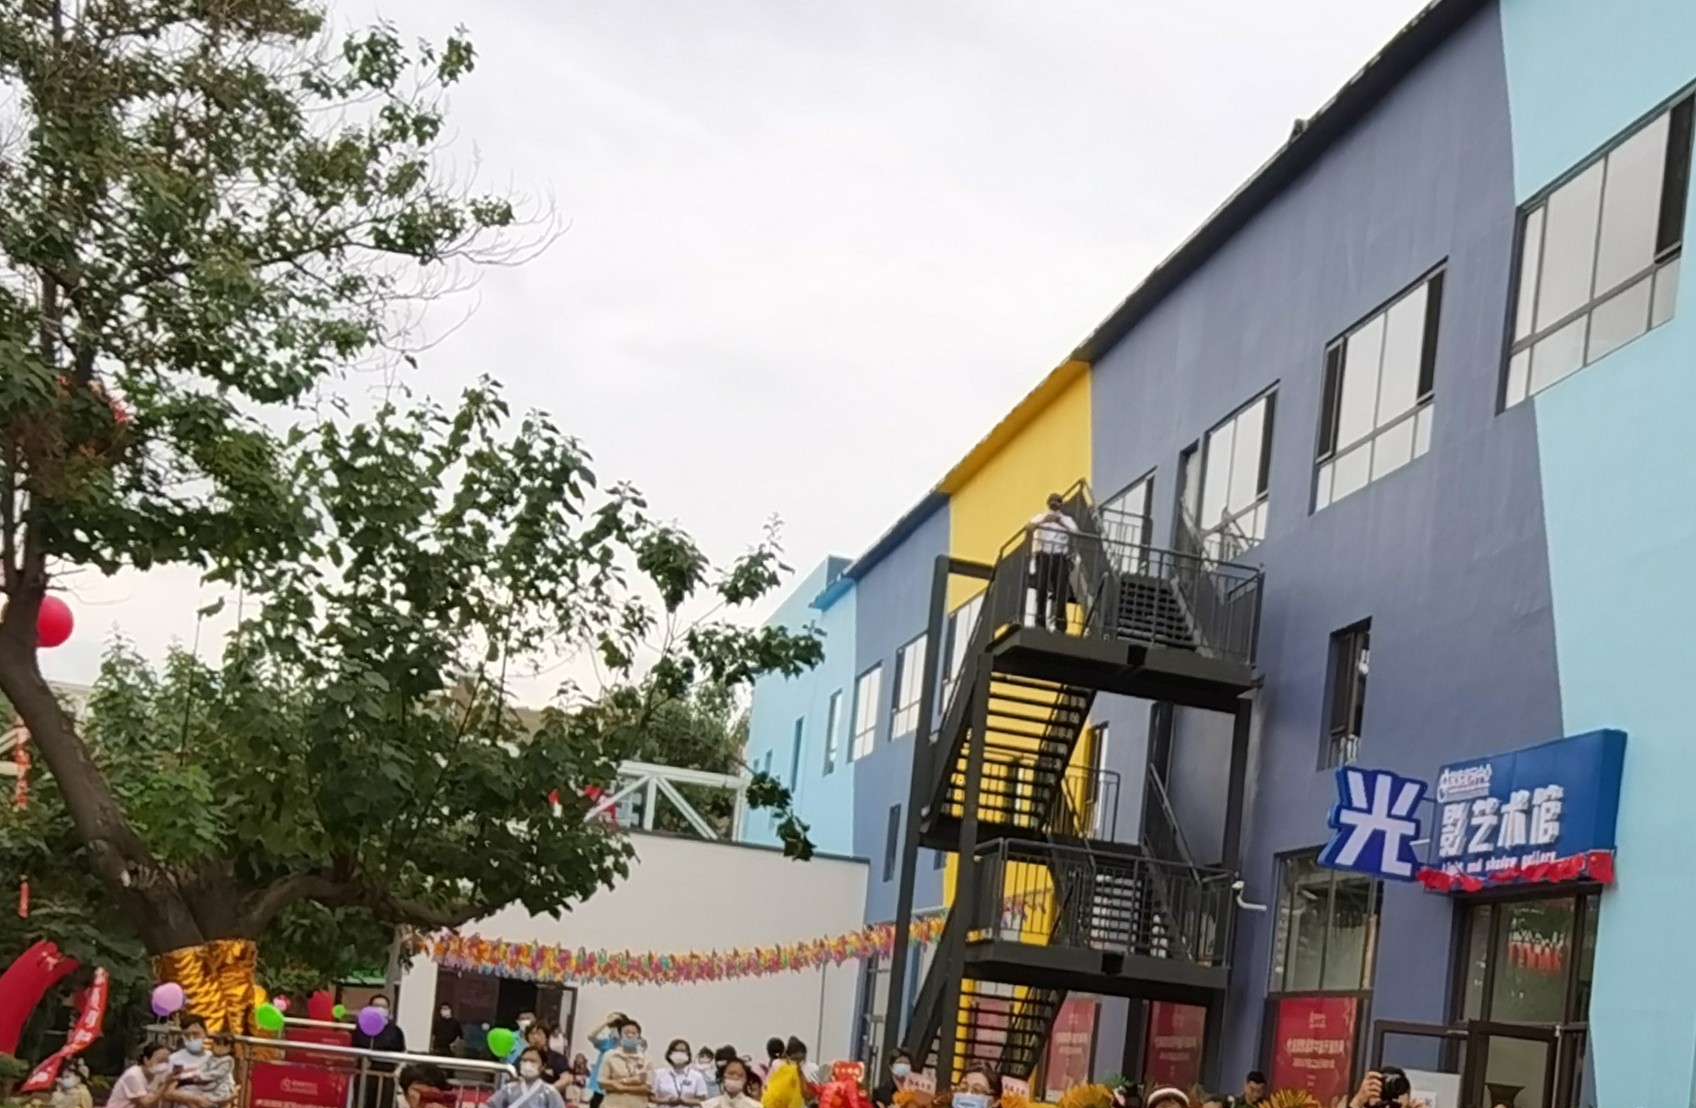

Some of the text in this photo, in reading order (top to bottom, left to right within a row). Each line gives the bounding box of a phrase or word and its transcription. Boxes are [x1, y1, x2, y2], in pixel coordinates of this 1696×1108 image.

[1335, 770, 1419, 877] 光
[1439, 784, 1564, 857] 影艺术馆
